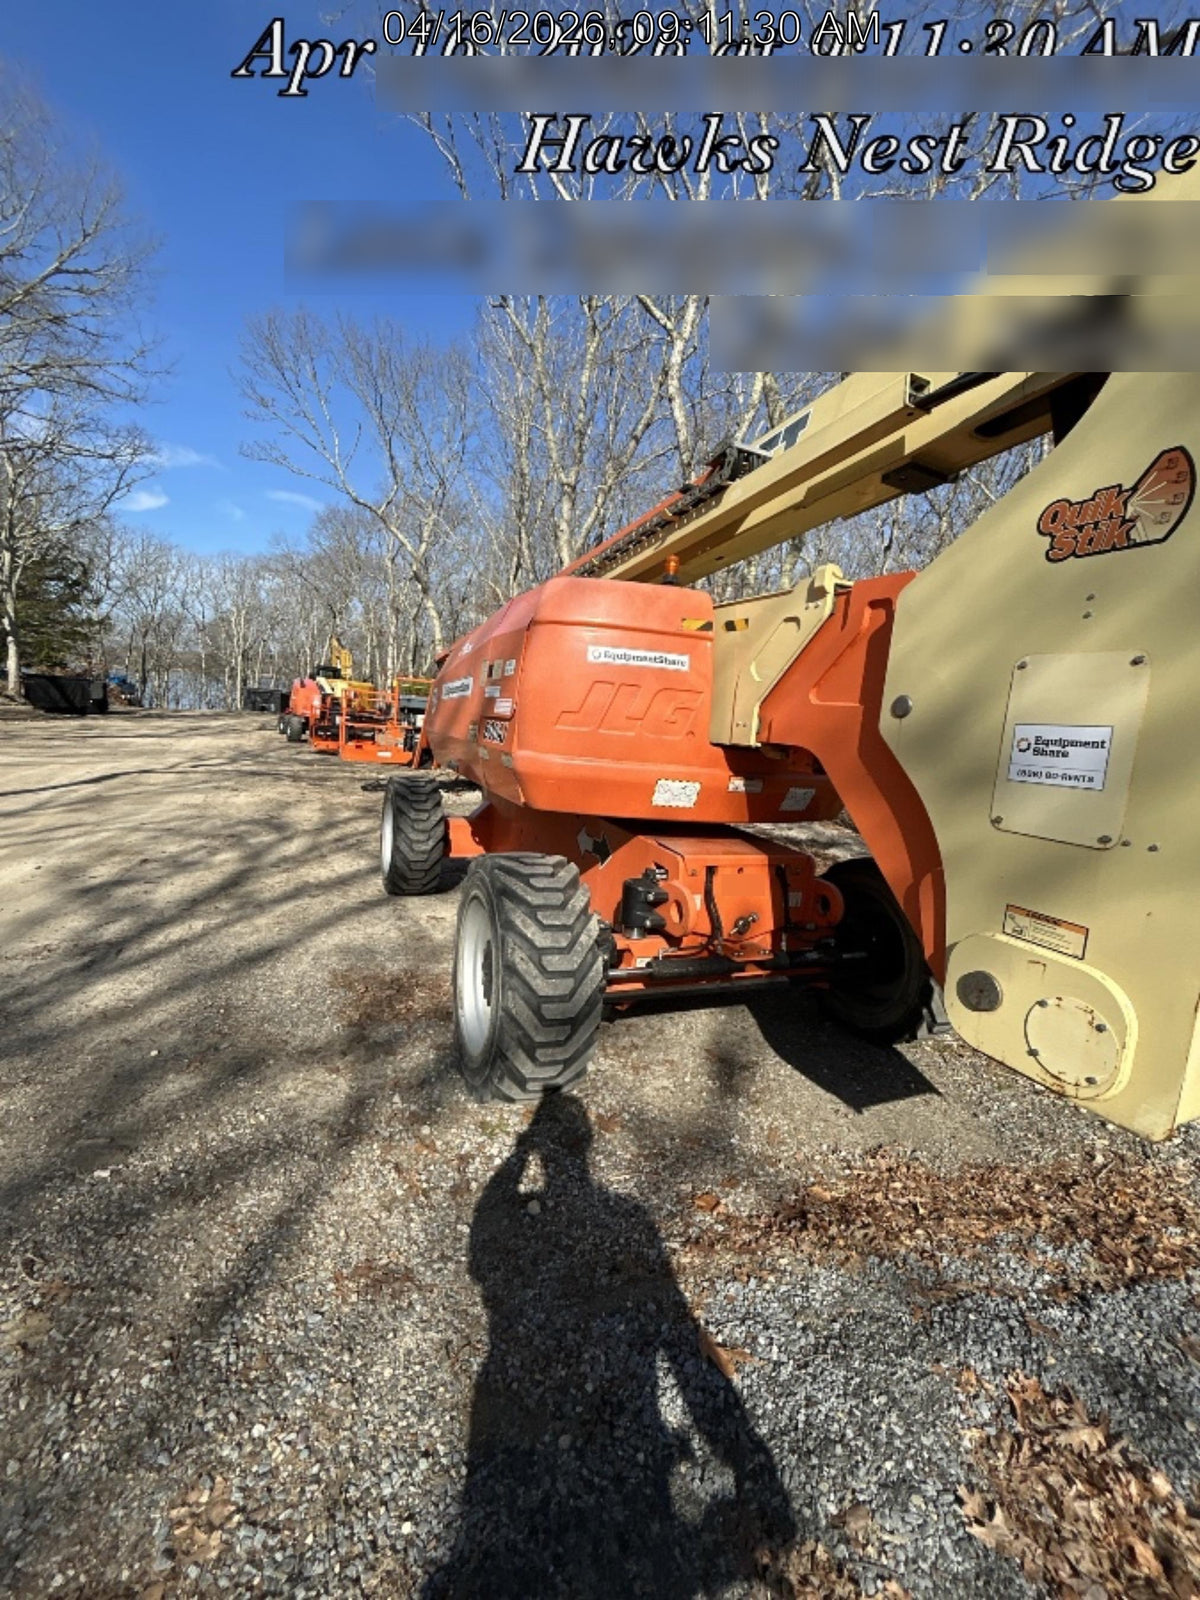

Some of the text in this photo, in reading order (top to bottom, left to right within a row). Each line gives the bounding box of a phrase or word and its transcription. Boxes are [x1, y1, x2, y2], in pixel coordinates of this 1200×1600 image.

[554, 680, 704, 740] JLG
[1034, 735, 1107, 750] Equipment
[1032, 746, 1070, 758] Share
